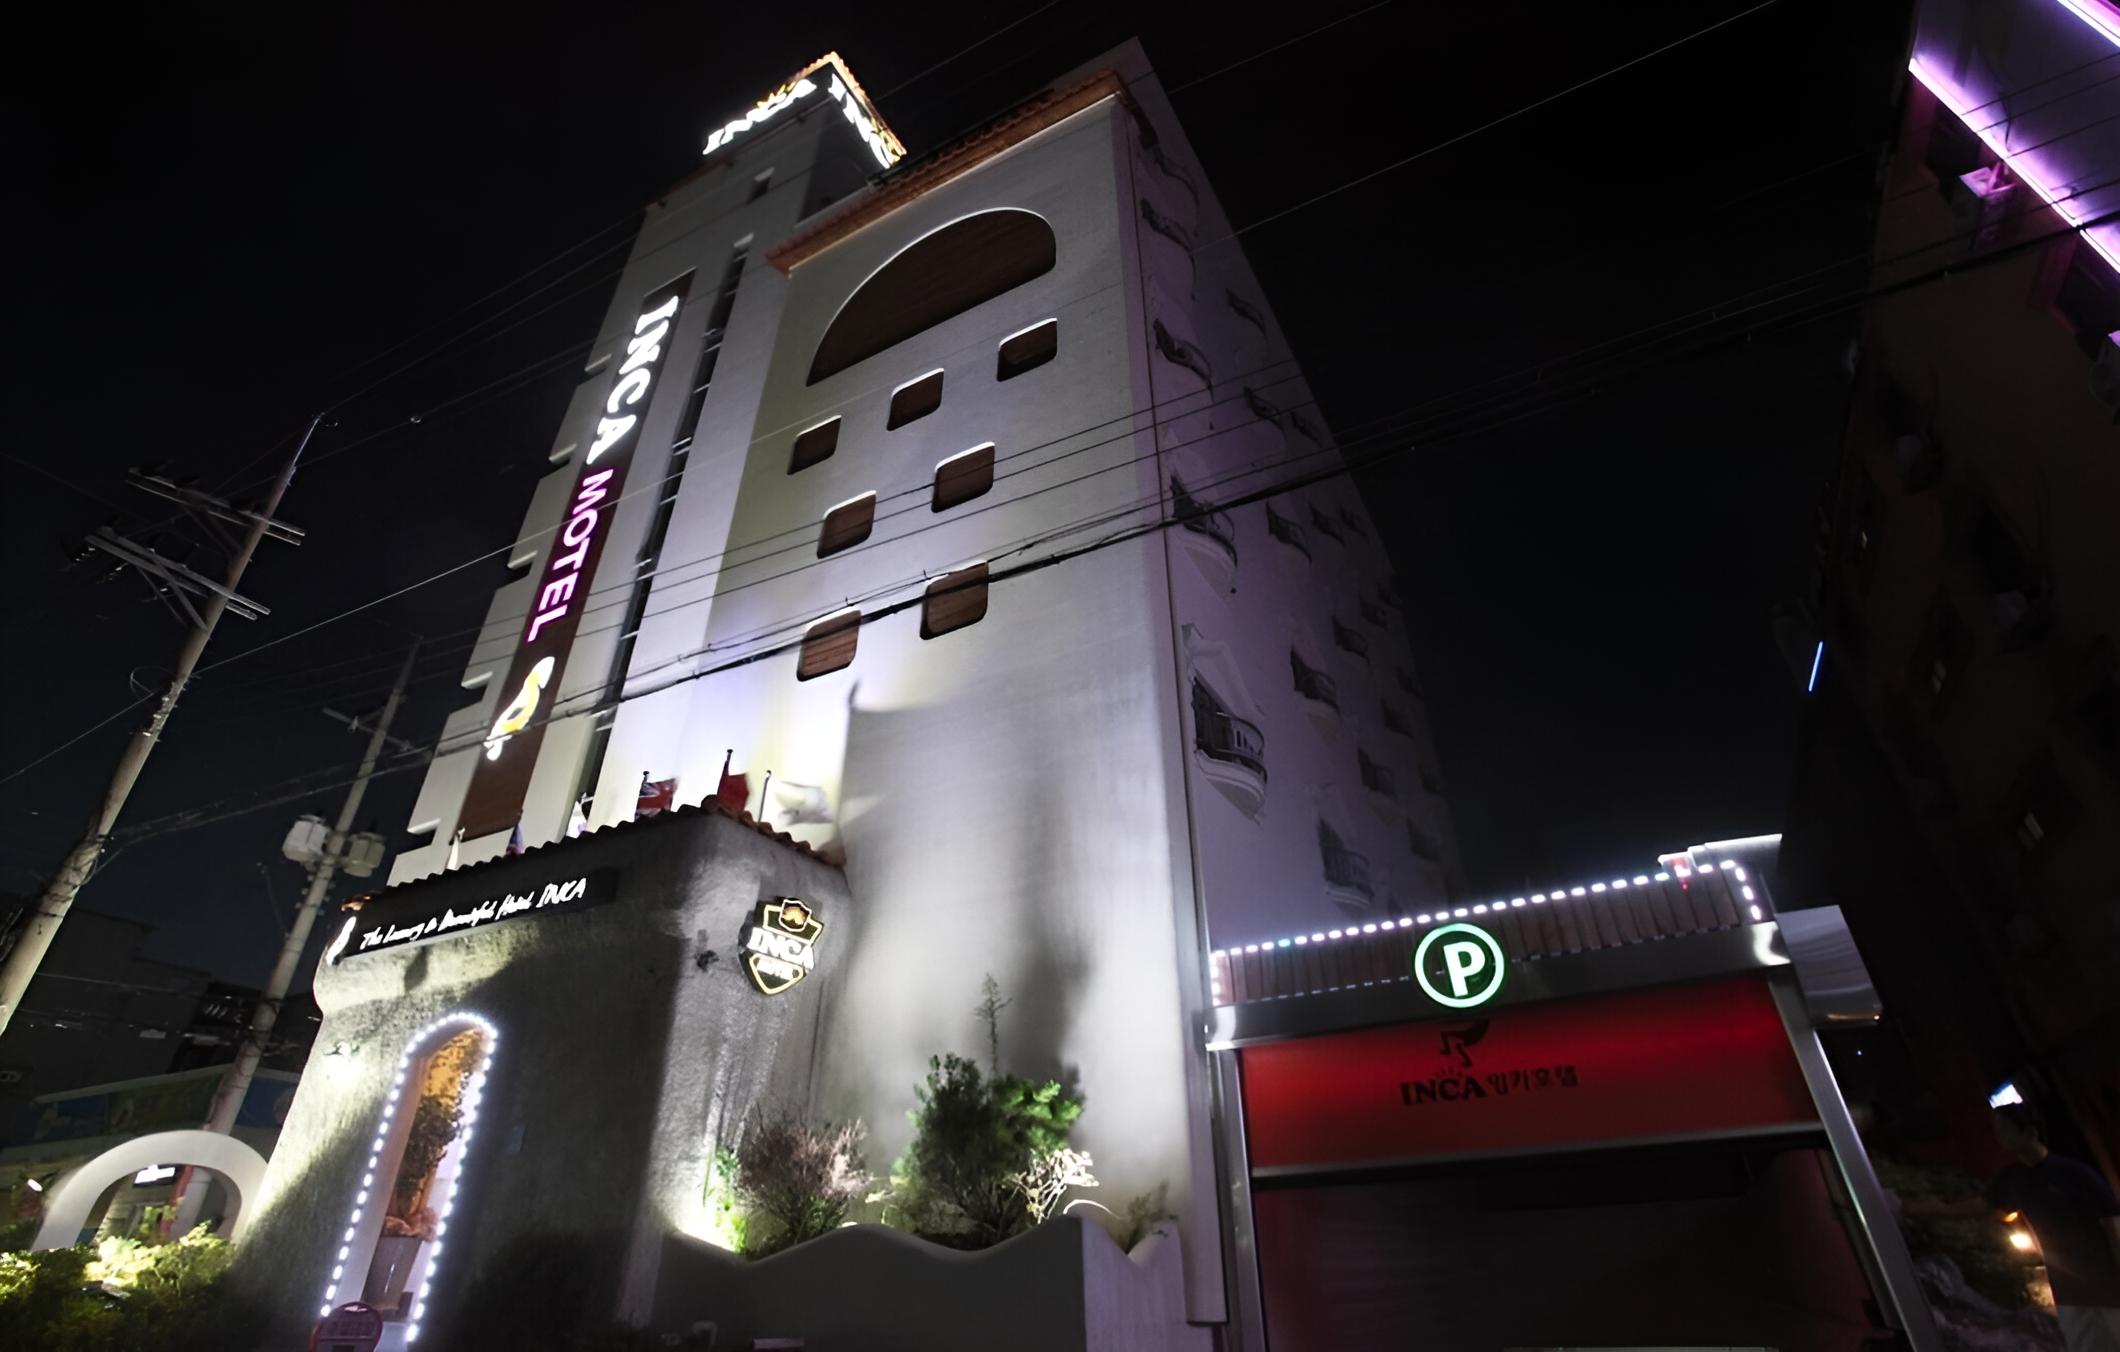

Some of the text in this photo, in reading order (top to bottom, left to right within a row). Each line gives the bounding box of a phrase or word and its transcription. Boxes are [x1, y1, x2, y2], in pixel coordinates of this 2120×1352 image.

[526, 295, 680, 644] INCA MOTEL
[535, 878, 587, 908] INCA
[746, 926, 815, 971] INCA
[1443, 941, 1486, 997] P
[1400, 1075, 1487, 1106] INCA
